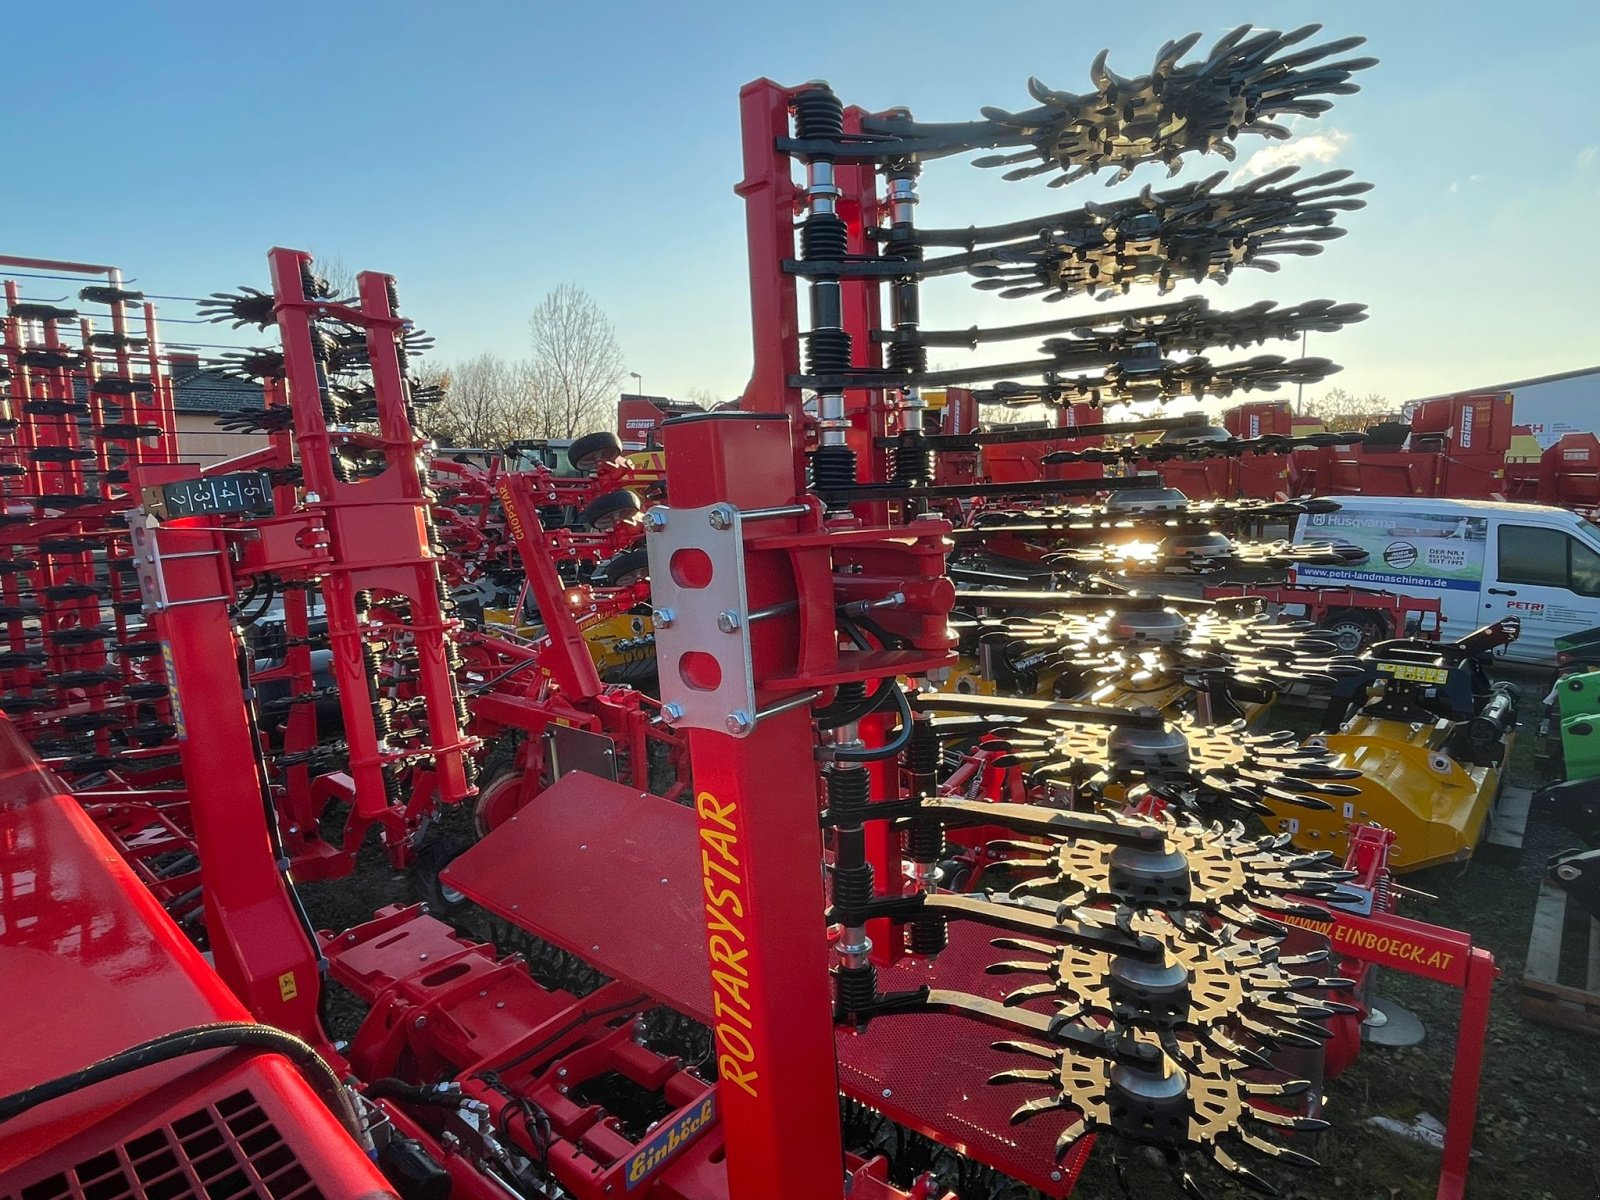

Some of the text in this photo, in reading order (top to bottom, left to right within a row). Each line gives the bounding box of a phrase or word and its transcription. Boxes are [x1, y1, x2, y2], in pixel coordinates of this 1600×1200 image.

[1462, 405, 1474, 448] GRIMME
[193, 491, 211, 502] 3
[220, 488, 236, 498] 4
[244, 487, 260, 497] 5
[500, 484, 525, 540] CHOPSTAR
[1327, 514, 1396, 529] Husqvarna
[1304, 567, 1448, 587] www.petri-landmaschinen.de
[1506, 601, 1545, 611] PETRI
[697, 792, 758, 1098] ROTARYSTAR
[629, 1099, 712, 1182] Einböck
